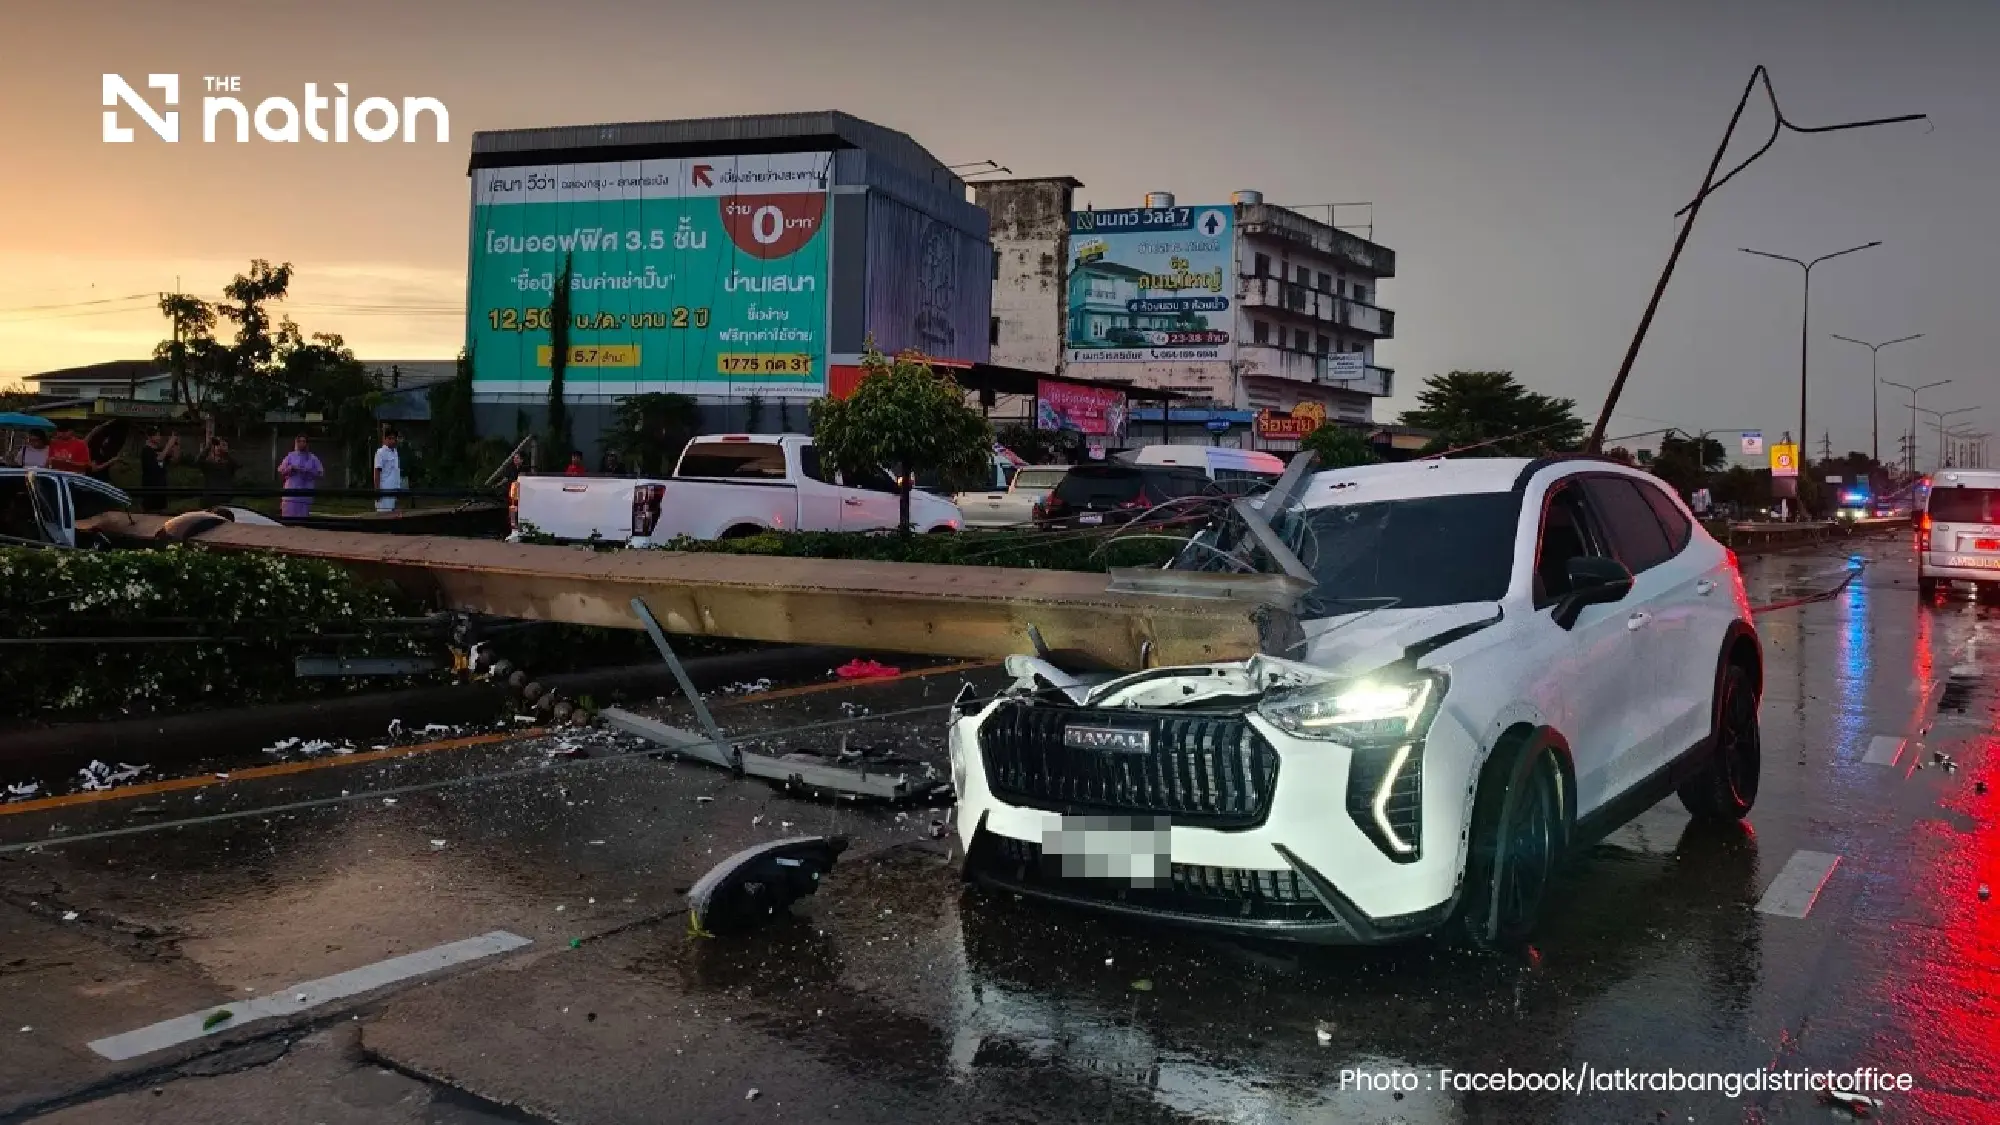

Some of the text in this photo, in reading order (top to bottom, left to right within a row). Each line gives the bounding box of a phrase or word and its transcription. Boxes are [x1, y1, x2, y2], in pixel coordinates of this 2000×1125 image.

[752, 205, 784, 244] 0
[1179, 208, 1190, 223] 7
[626, 230, 664, 250] 3.5
[673, 216, 707, 249] ชั้น
[724, 269, 815, 292] บ้านเสนา
[488, 306, 571, 333] 12,50
[630, 311, 666, 329] นาน
[671, 305, 690, 328] 2
[694, 307, 710, 329] ปี
[575, 350, 598, 363] 5.7
[722, 358, 759, 371] 1775
[765, 357, 787, 371] กด
